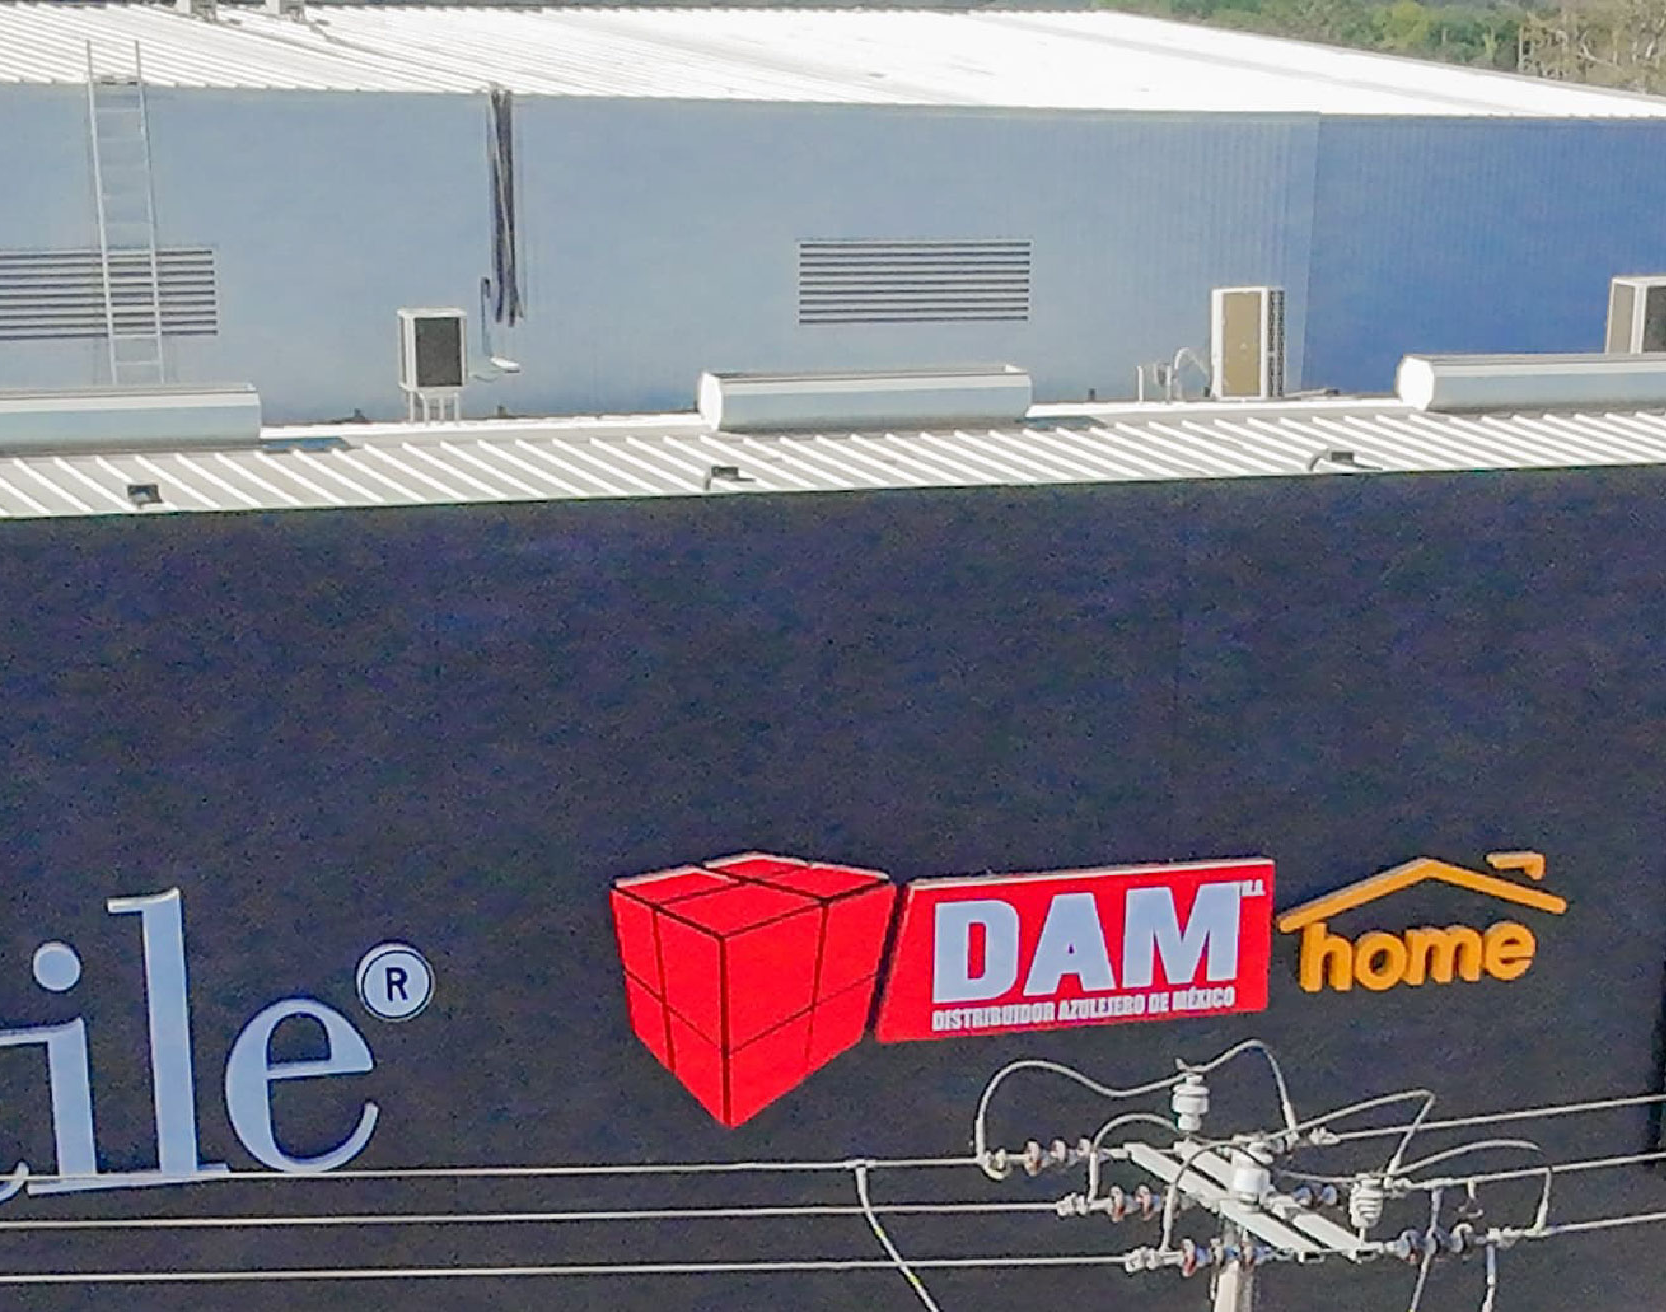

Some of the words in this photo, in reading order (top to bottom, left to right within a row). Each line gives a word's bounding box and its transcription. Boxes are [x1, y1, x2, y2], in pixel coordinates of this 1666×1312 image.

[933, 882, 1241, 1004] DAM
[1299, 920, 1537, 992] home
[1148, 991, 1170, 1014] DE
